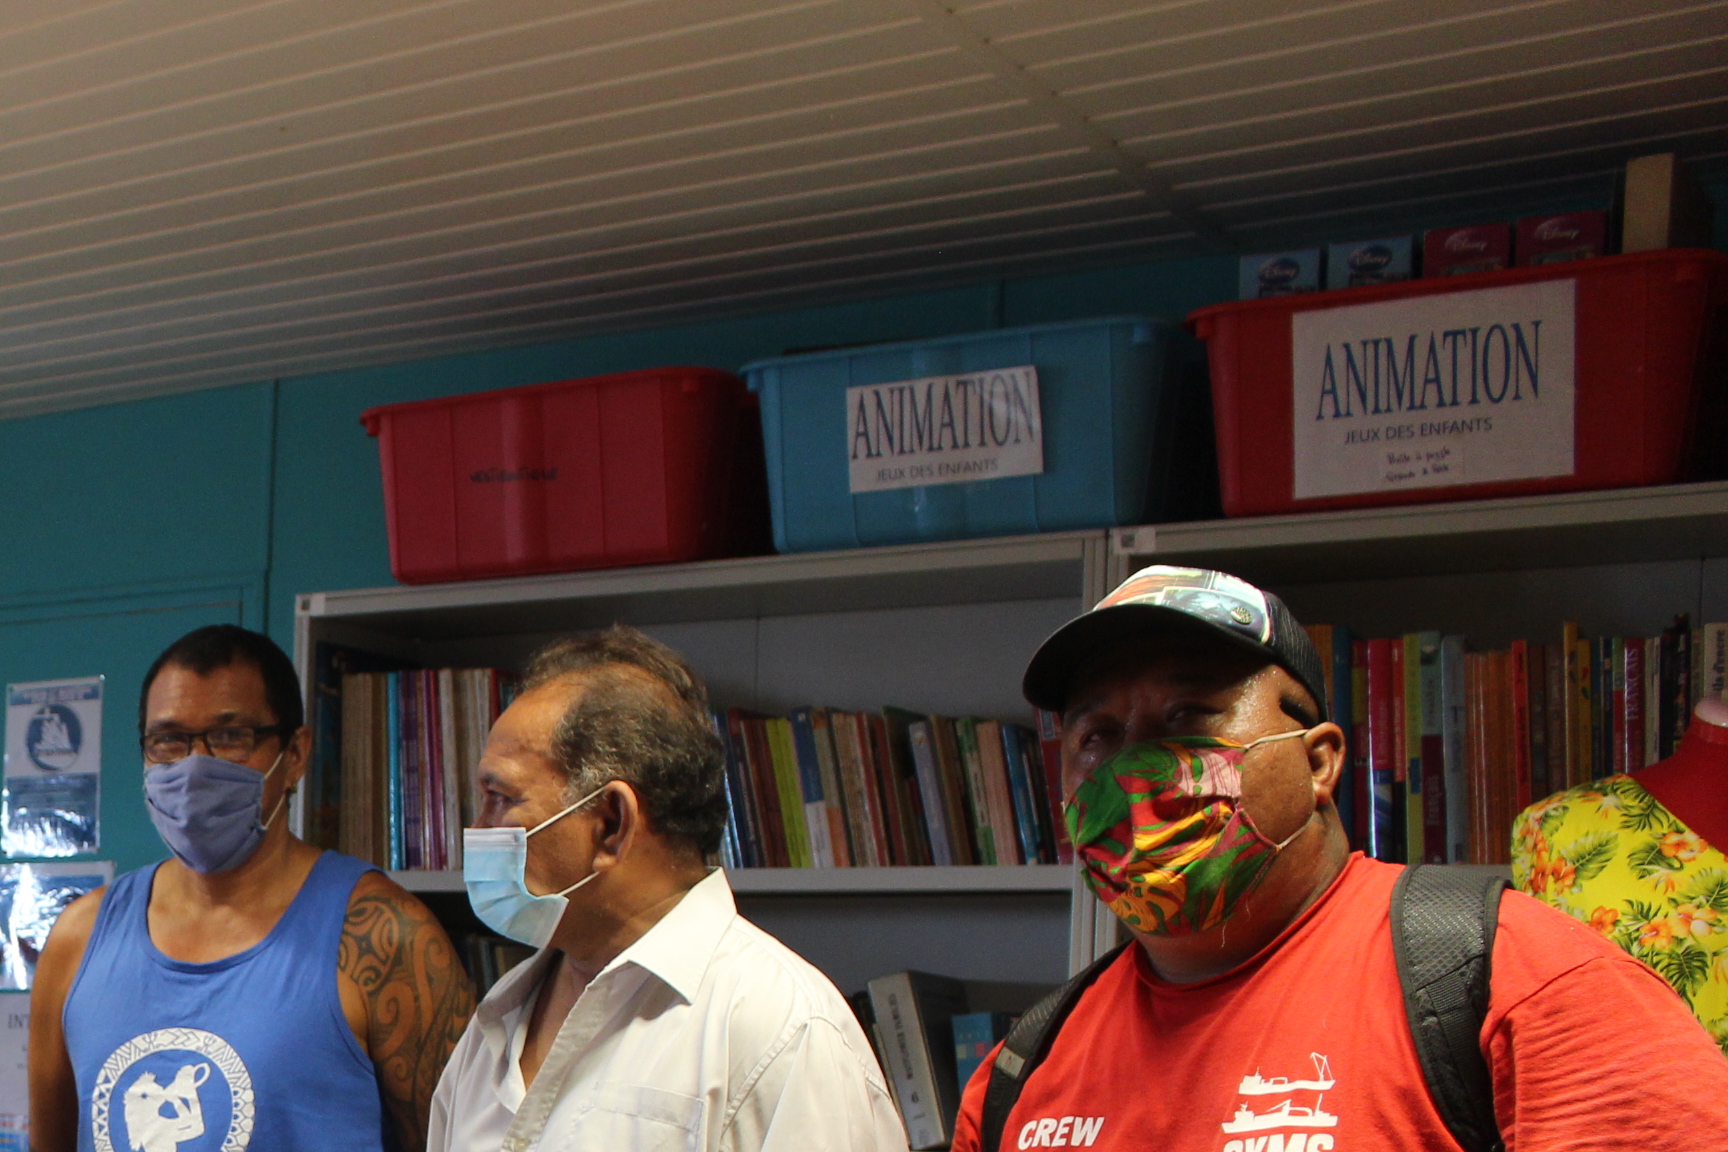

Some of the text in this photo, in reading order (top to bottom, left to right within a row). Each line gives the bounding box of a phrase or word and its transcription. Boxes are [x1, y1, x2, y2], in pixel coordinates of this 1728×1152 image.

[1316, 320, 1542, 421] ANIMATION
[851, 371, 1035, 460] ANIMATION
[1344, 417, 1493, 445] JEUX DES ENFANTS
[876, 458, 998, 482] JEUX DES ENFANTS
[1626, 648, 1639, 721] FRANÇAIS
[1017, 1115, 1105, 1151] CREW
